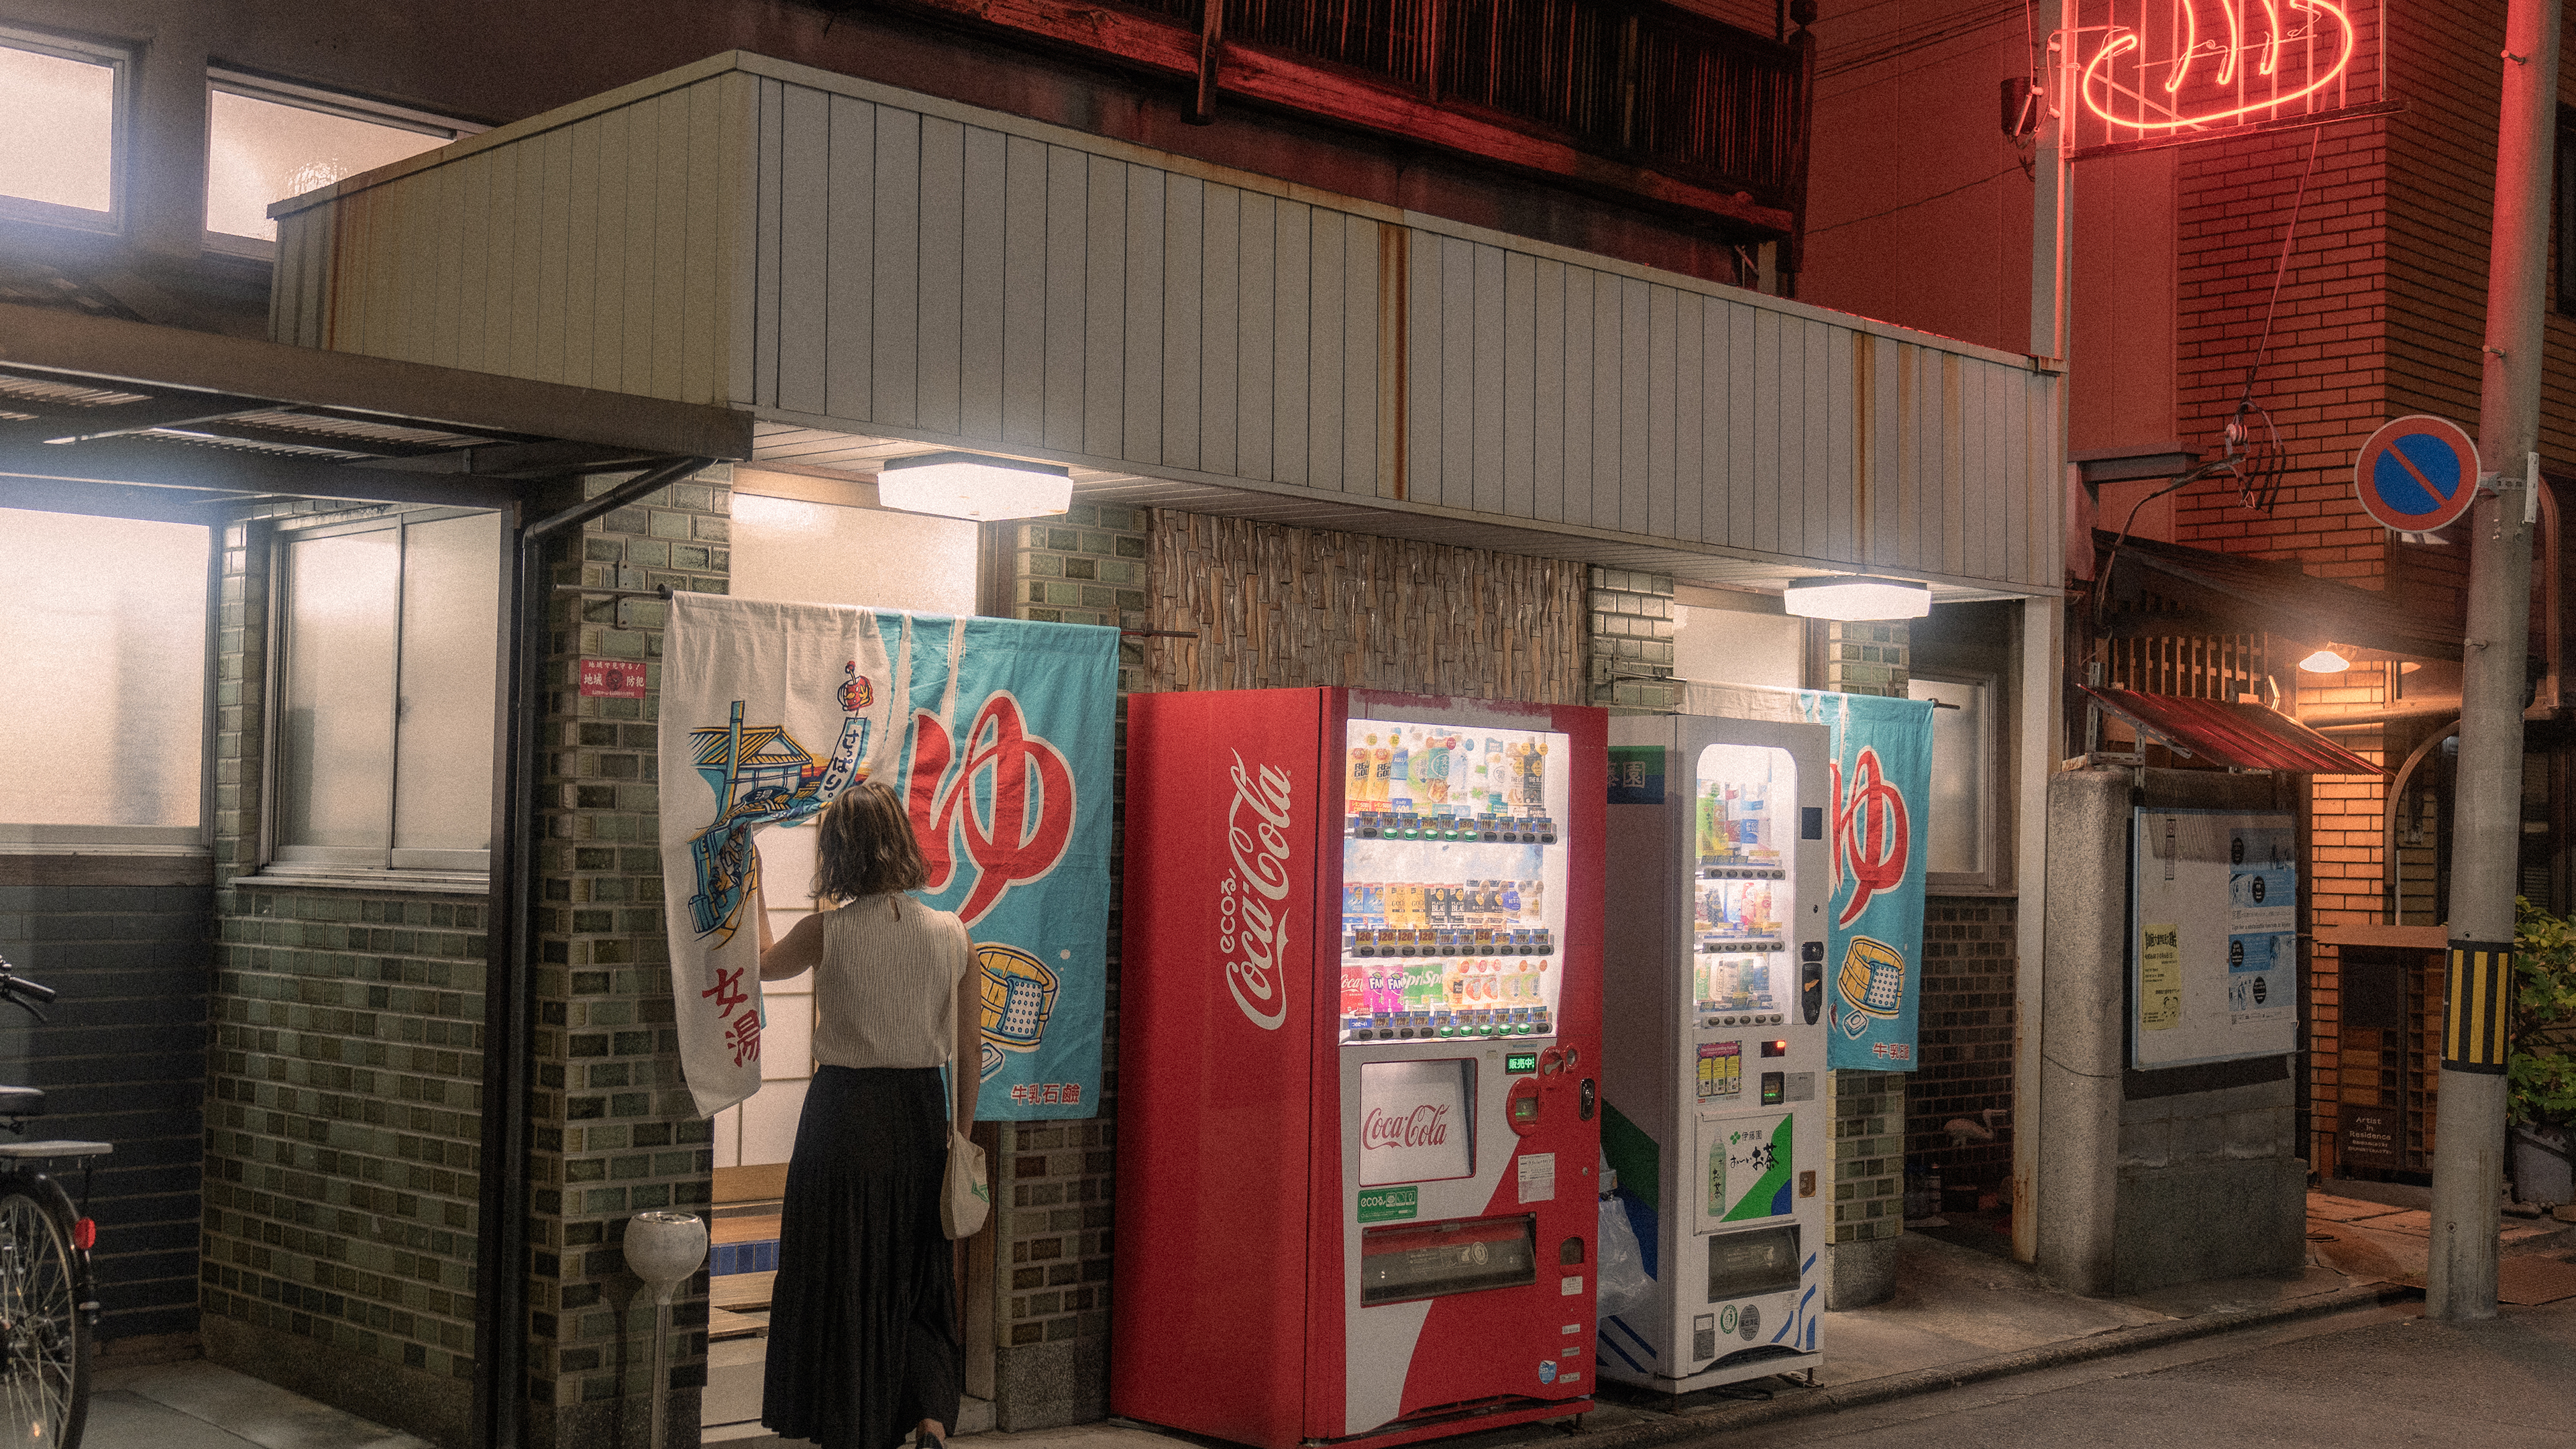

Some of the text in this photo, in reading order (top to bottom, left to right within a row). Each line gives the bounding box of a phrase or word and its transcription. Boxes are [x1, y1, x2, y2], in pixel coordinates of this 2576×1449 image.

[584, 673, 645, 687] 地域 防犯
[903, 690, 1076, 930] ゆ
[1226, 747, 1291, 1030] Coca-Cola
[702, 967, 760, 1068] 女湯
[1362, 1104, 1450, 1150] Coca-Cola
[2349, 1130, 2392, 1140] Residence
[2355, 1116, 2381, 1124] Artist
[1741, 1130, 1762, 1141] 伊藤園
